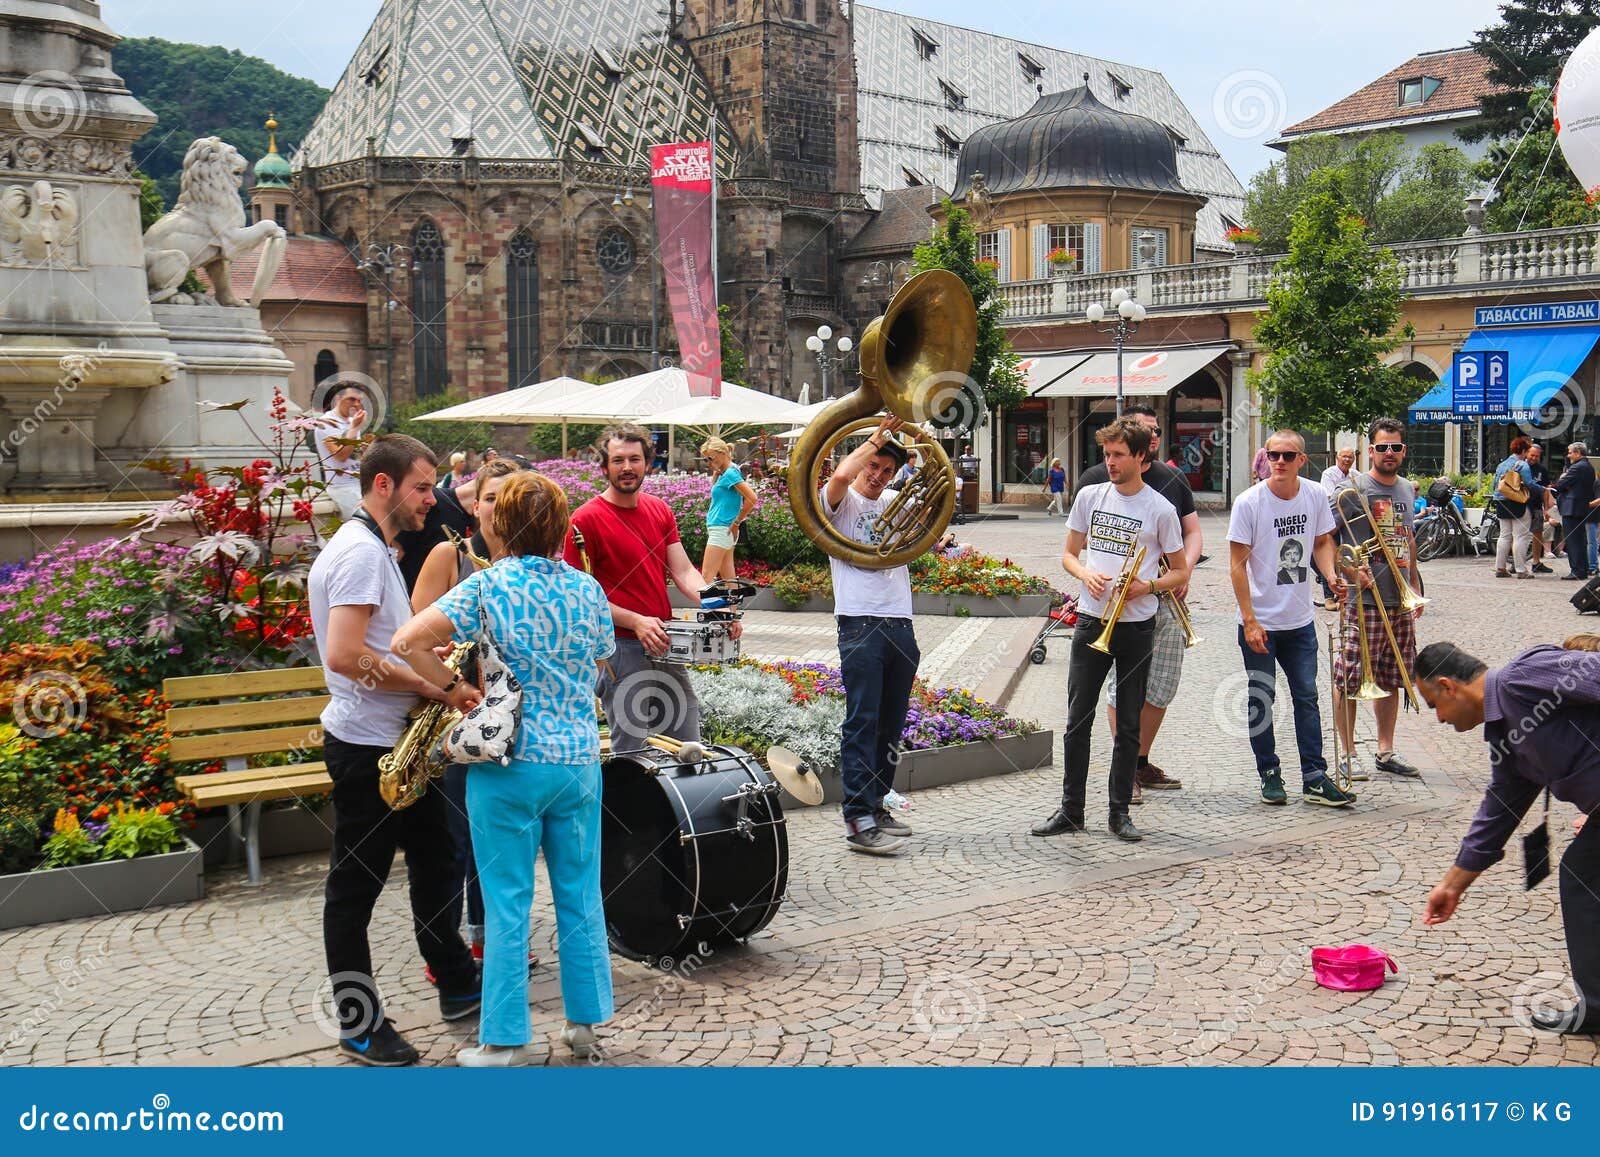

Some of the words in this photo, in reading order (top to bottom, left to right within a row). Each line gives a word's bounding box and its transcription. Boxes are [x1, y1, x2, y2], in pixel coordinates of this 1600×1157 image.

[1479, 307, 1543, 323] TABACCHI
[1549, 303, 1595, 320] TABAK
[1459, 362, 1478, 387] P
[1490, 361, 1503, 386] P
[1274, 514, 1307, 528] ANGELO
[1278, 524, 1305, 538] MERTE
